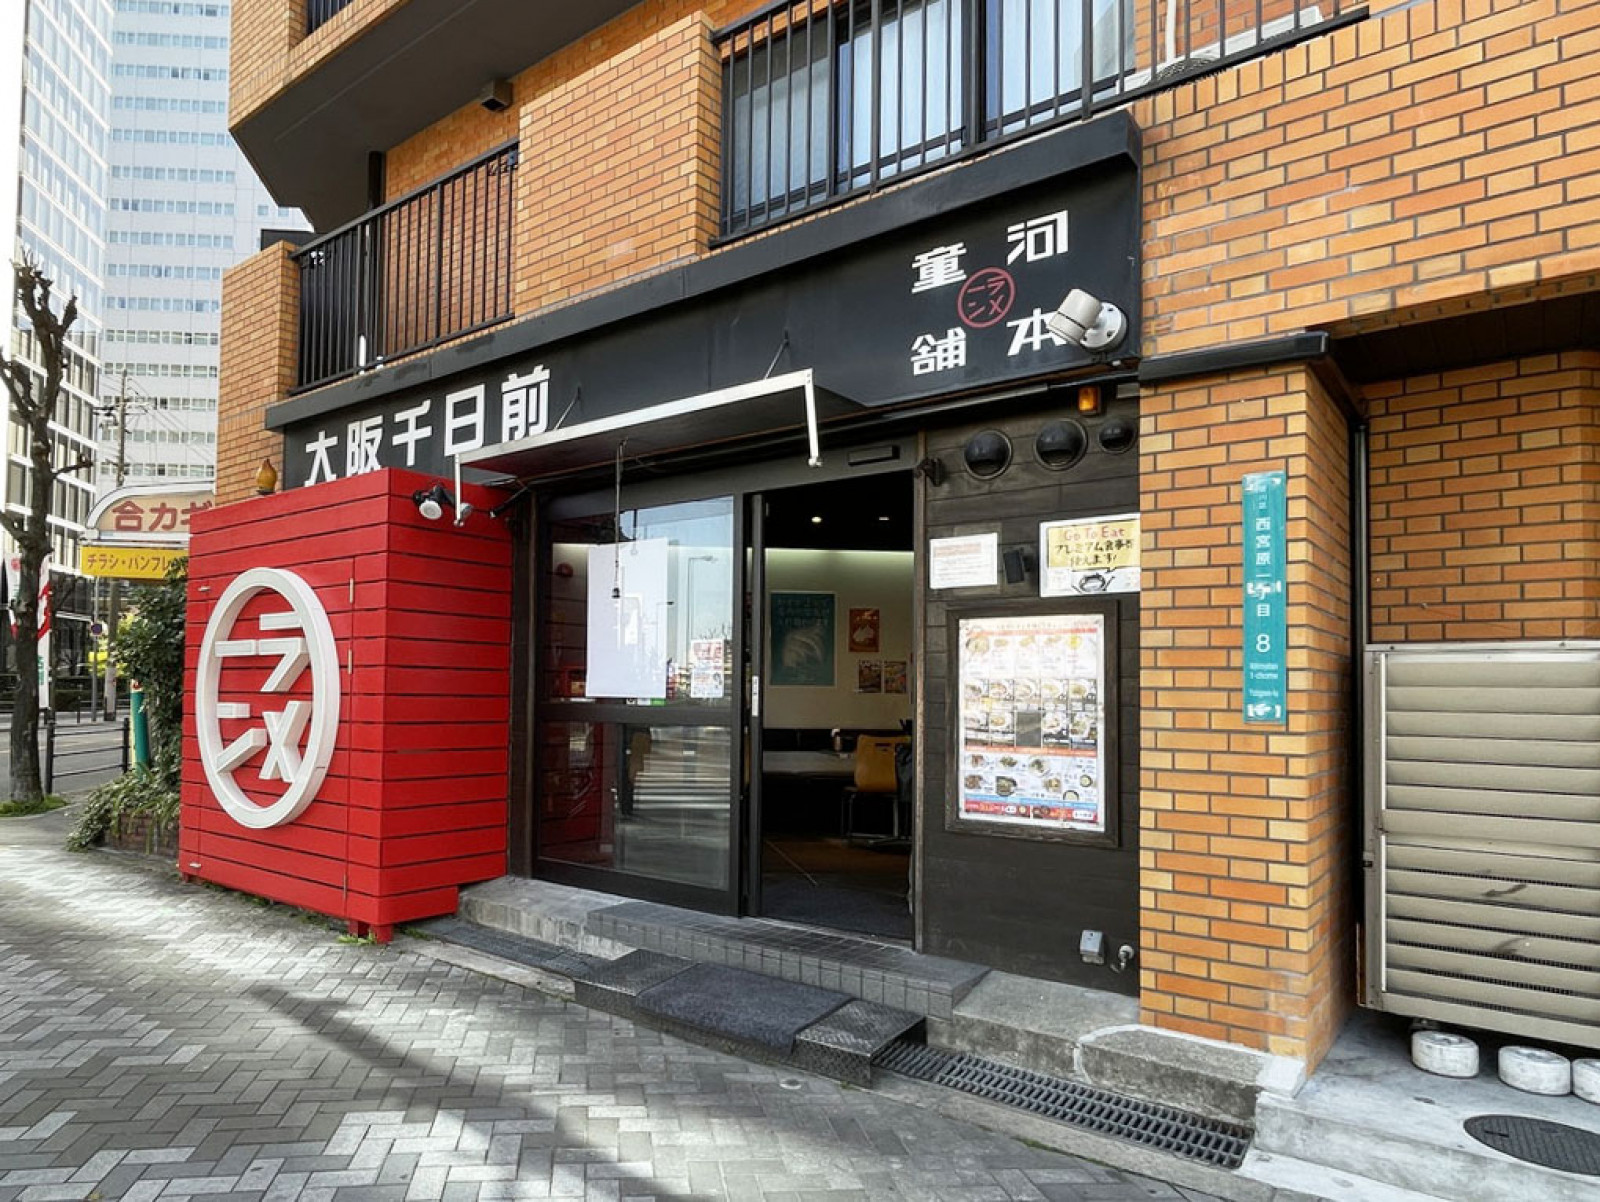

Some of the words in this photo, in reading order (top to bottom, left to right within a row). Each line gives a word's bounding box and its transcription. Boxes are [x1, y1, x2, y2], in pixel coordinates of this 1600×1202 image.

[304, 364, 550, 487] 大阪千日前
[1064, 529, 1080, 541] Go
[1086, 527, 1097, 539] To
[1102, 525, 1125, 538] Eat
[1256, 633, 1270, 653] 8
